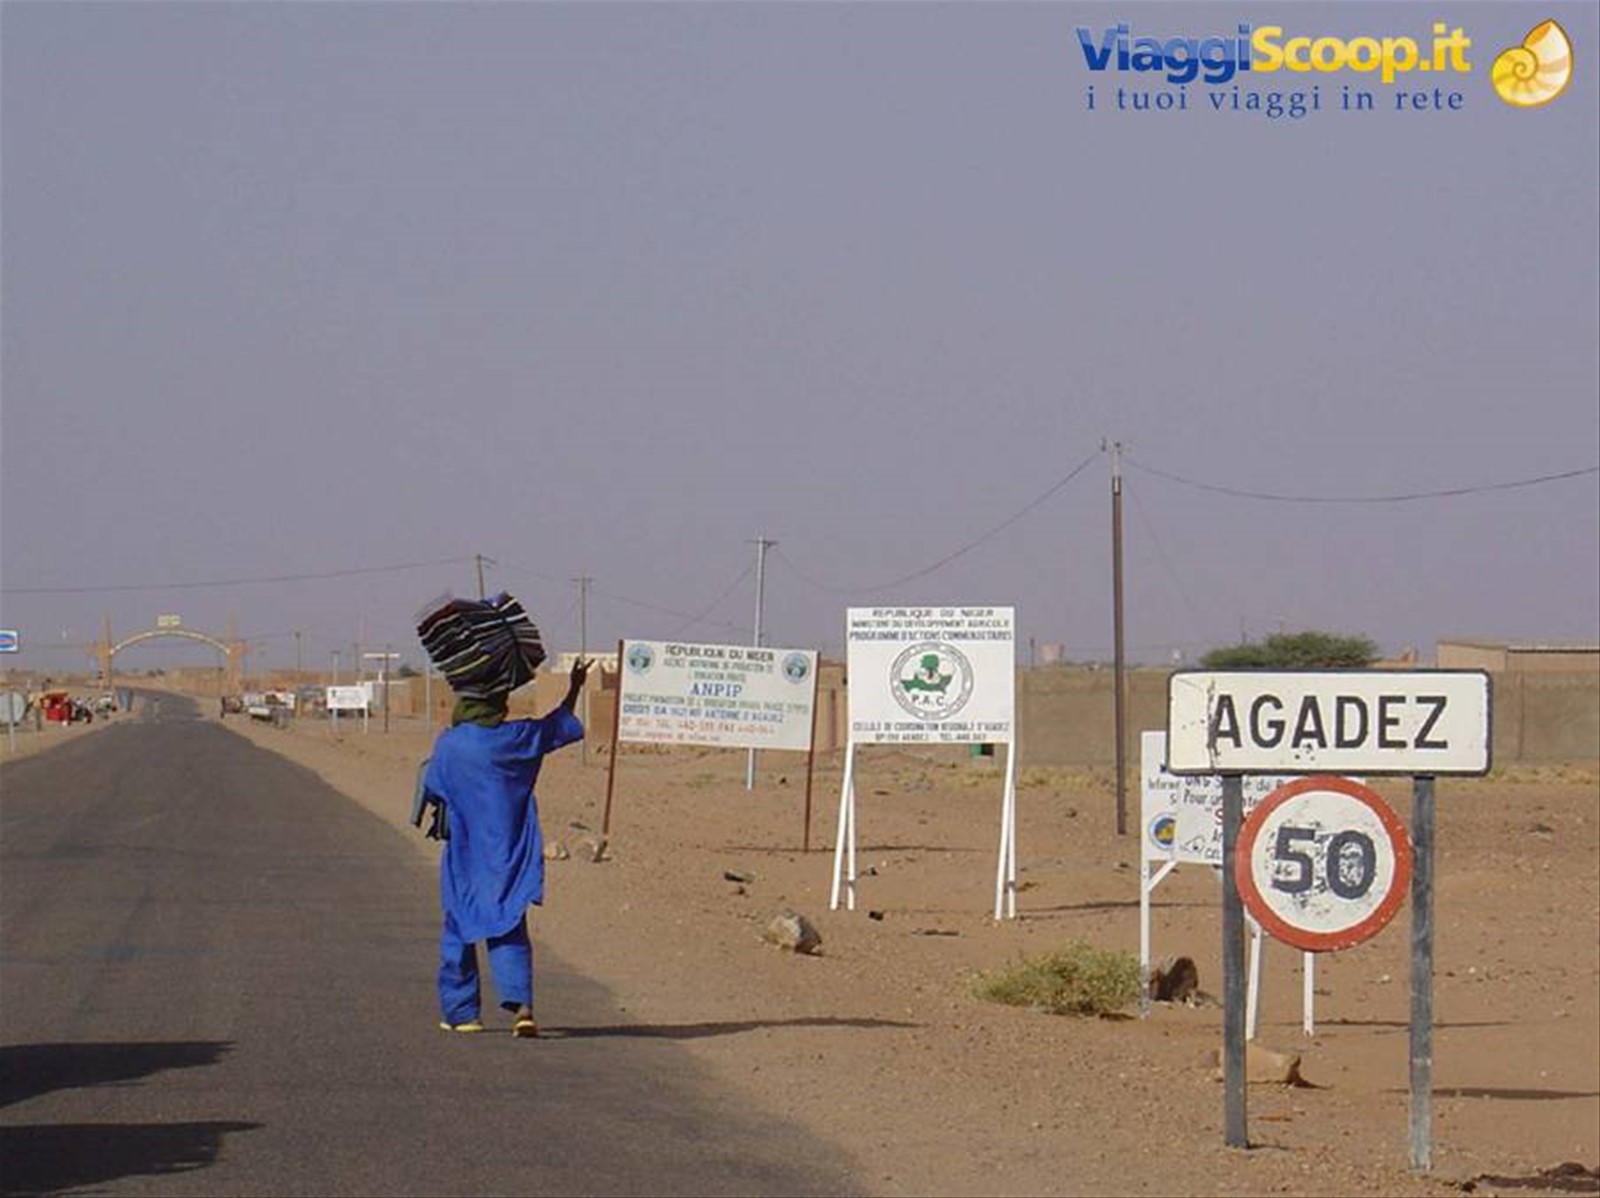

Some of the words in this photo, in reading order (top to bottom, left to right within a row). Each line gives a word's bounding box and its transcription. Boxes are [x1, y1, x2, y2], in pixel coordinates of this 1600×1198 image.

[691, 682, 743, 697] ANPIP
[1207, 694, 1449, 749] AGADEZ
[1270, 826, 1377, 899] 50
